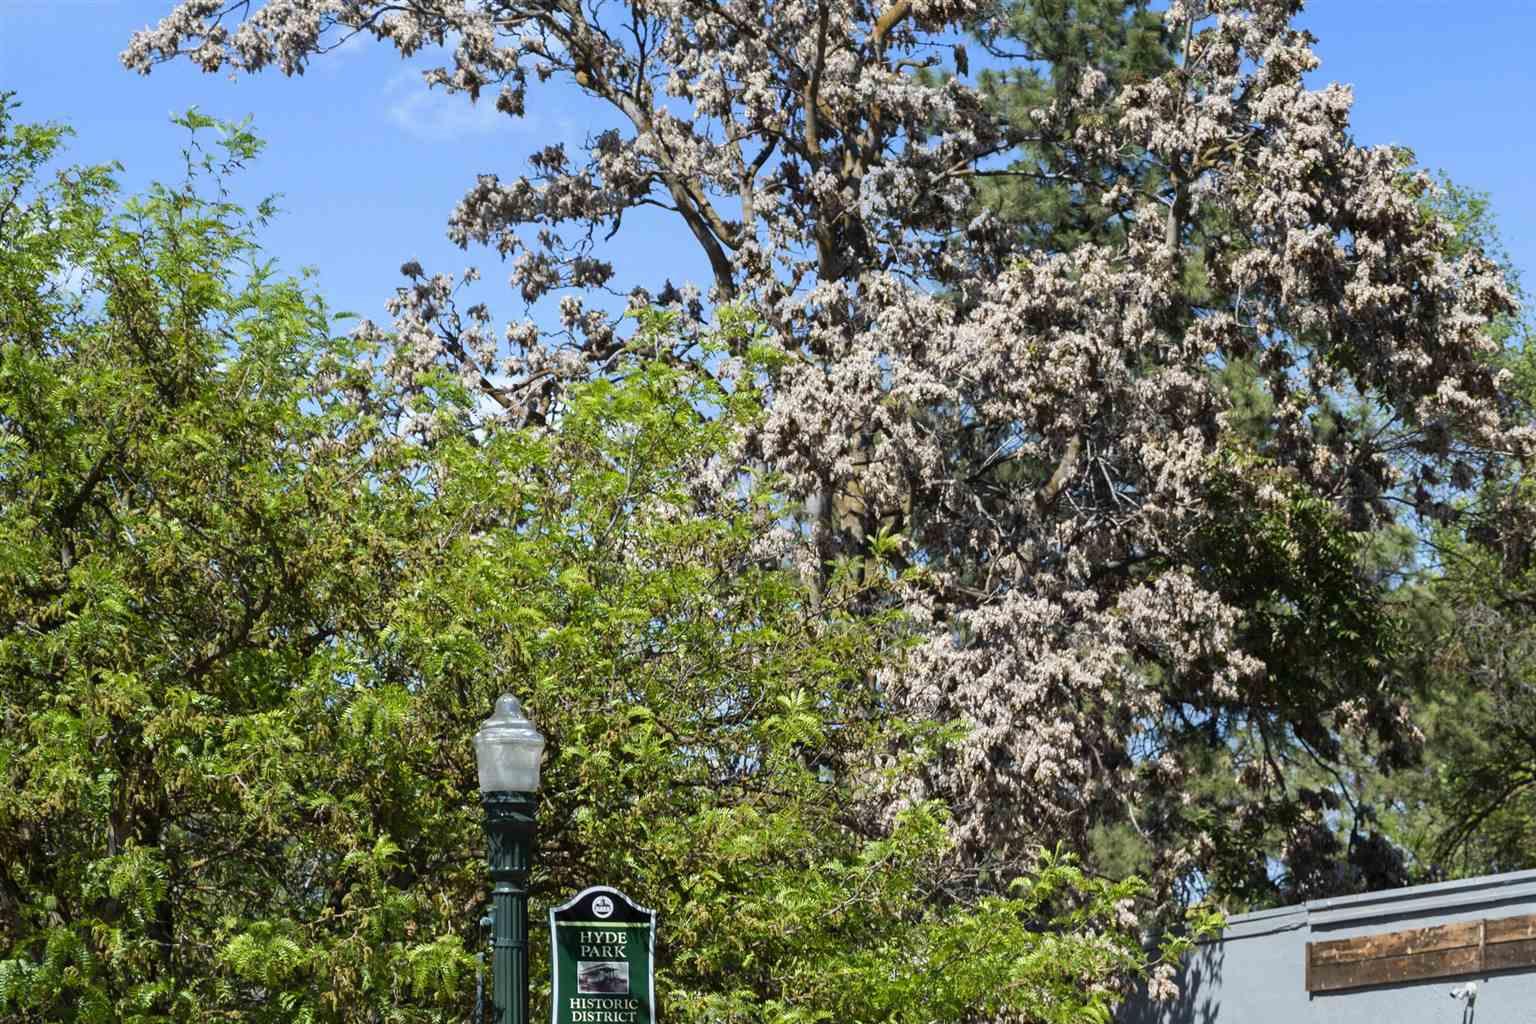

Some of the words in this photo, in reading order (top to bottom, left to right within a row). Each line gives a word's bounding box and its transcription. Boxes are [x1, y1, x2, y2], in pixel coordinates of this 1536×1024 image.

[580, 931, 628, 944] HYDE
[581, 945, 627, 958] PARK
[569, 998, 639, 1010] HISTORIC
[571, 1010, 637, 1022] DISTRICT
